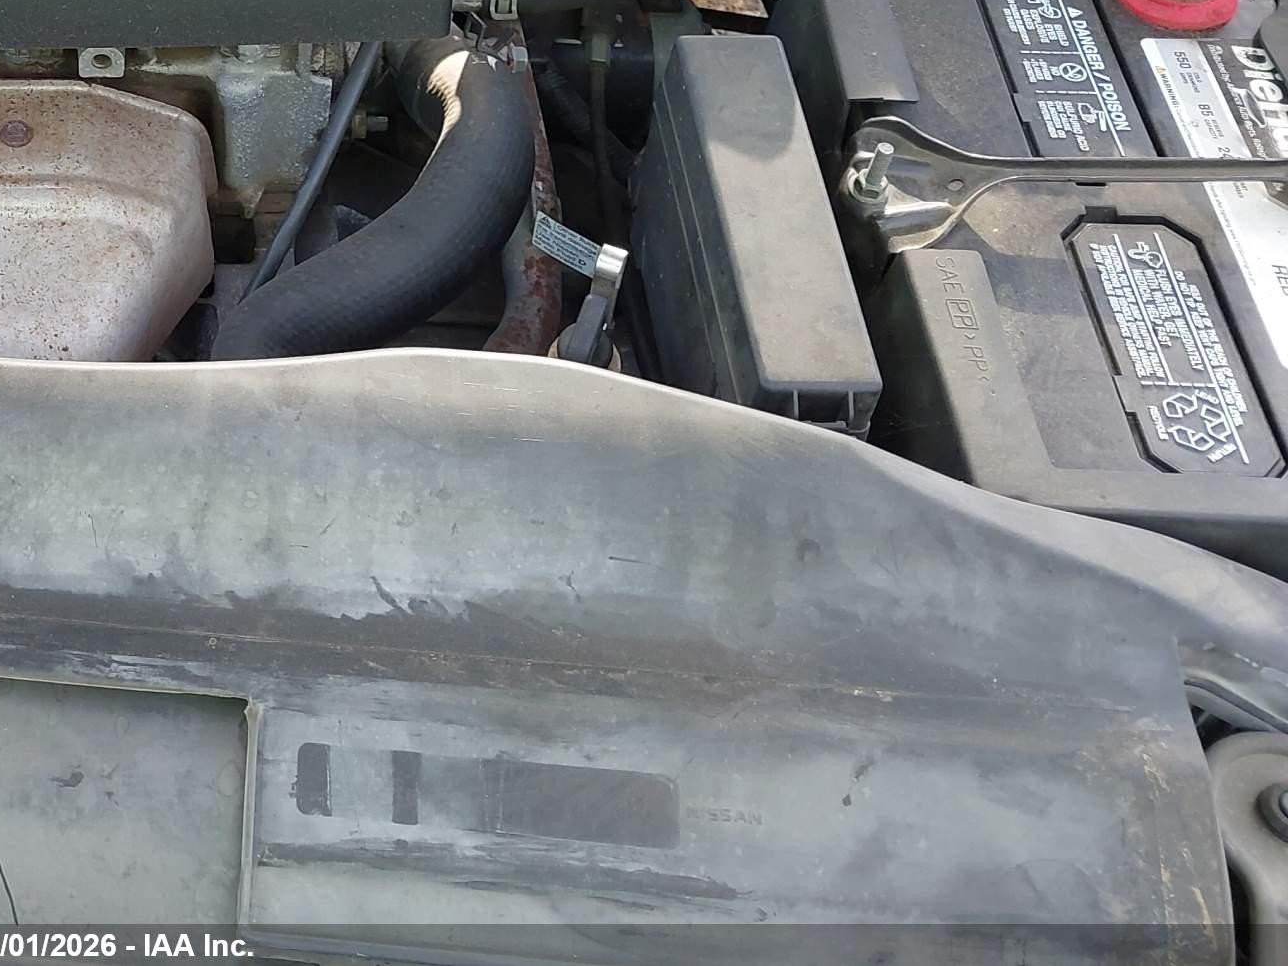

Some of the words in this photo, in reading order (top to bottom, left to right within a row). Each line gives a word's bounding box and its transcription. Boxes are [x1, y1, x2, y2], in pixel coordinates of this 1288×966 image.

[1072, 20, 1105, 71] DANGER
[1098, 83, 1132, 131] POISON
[936, 257, 965, 293] SAE
